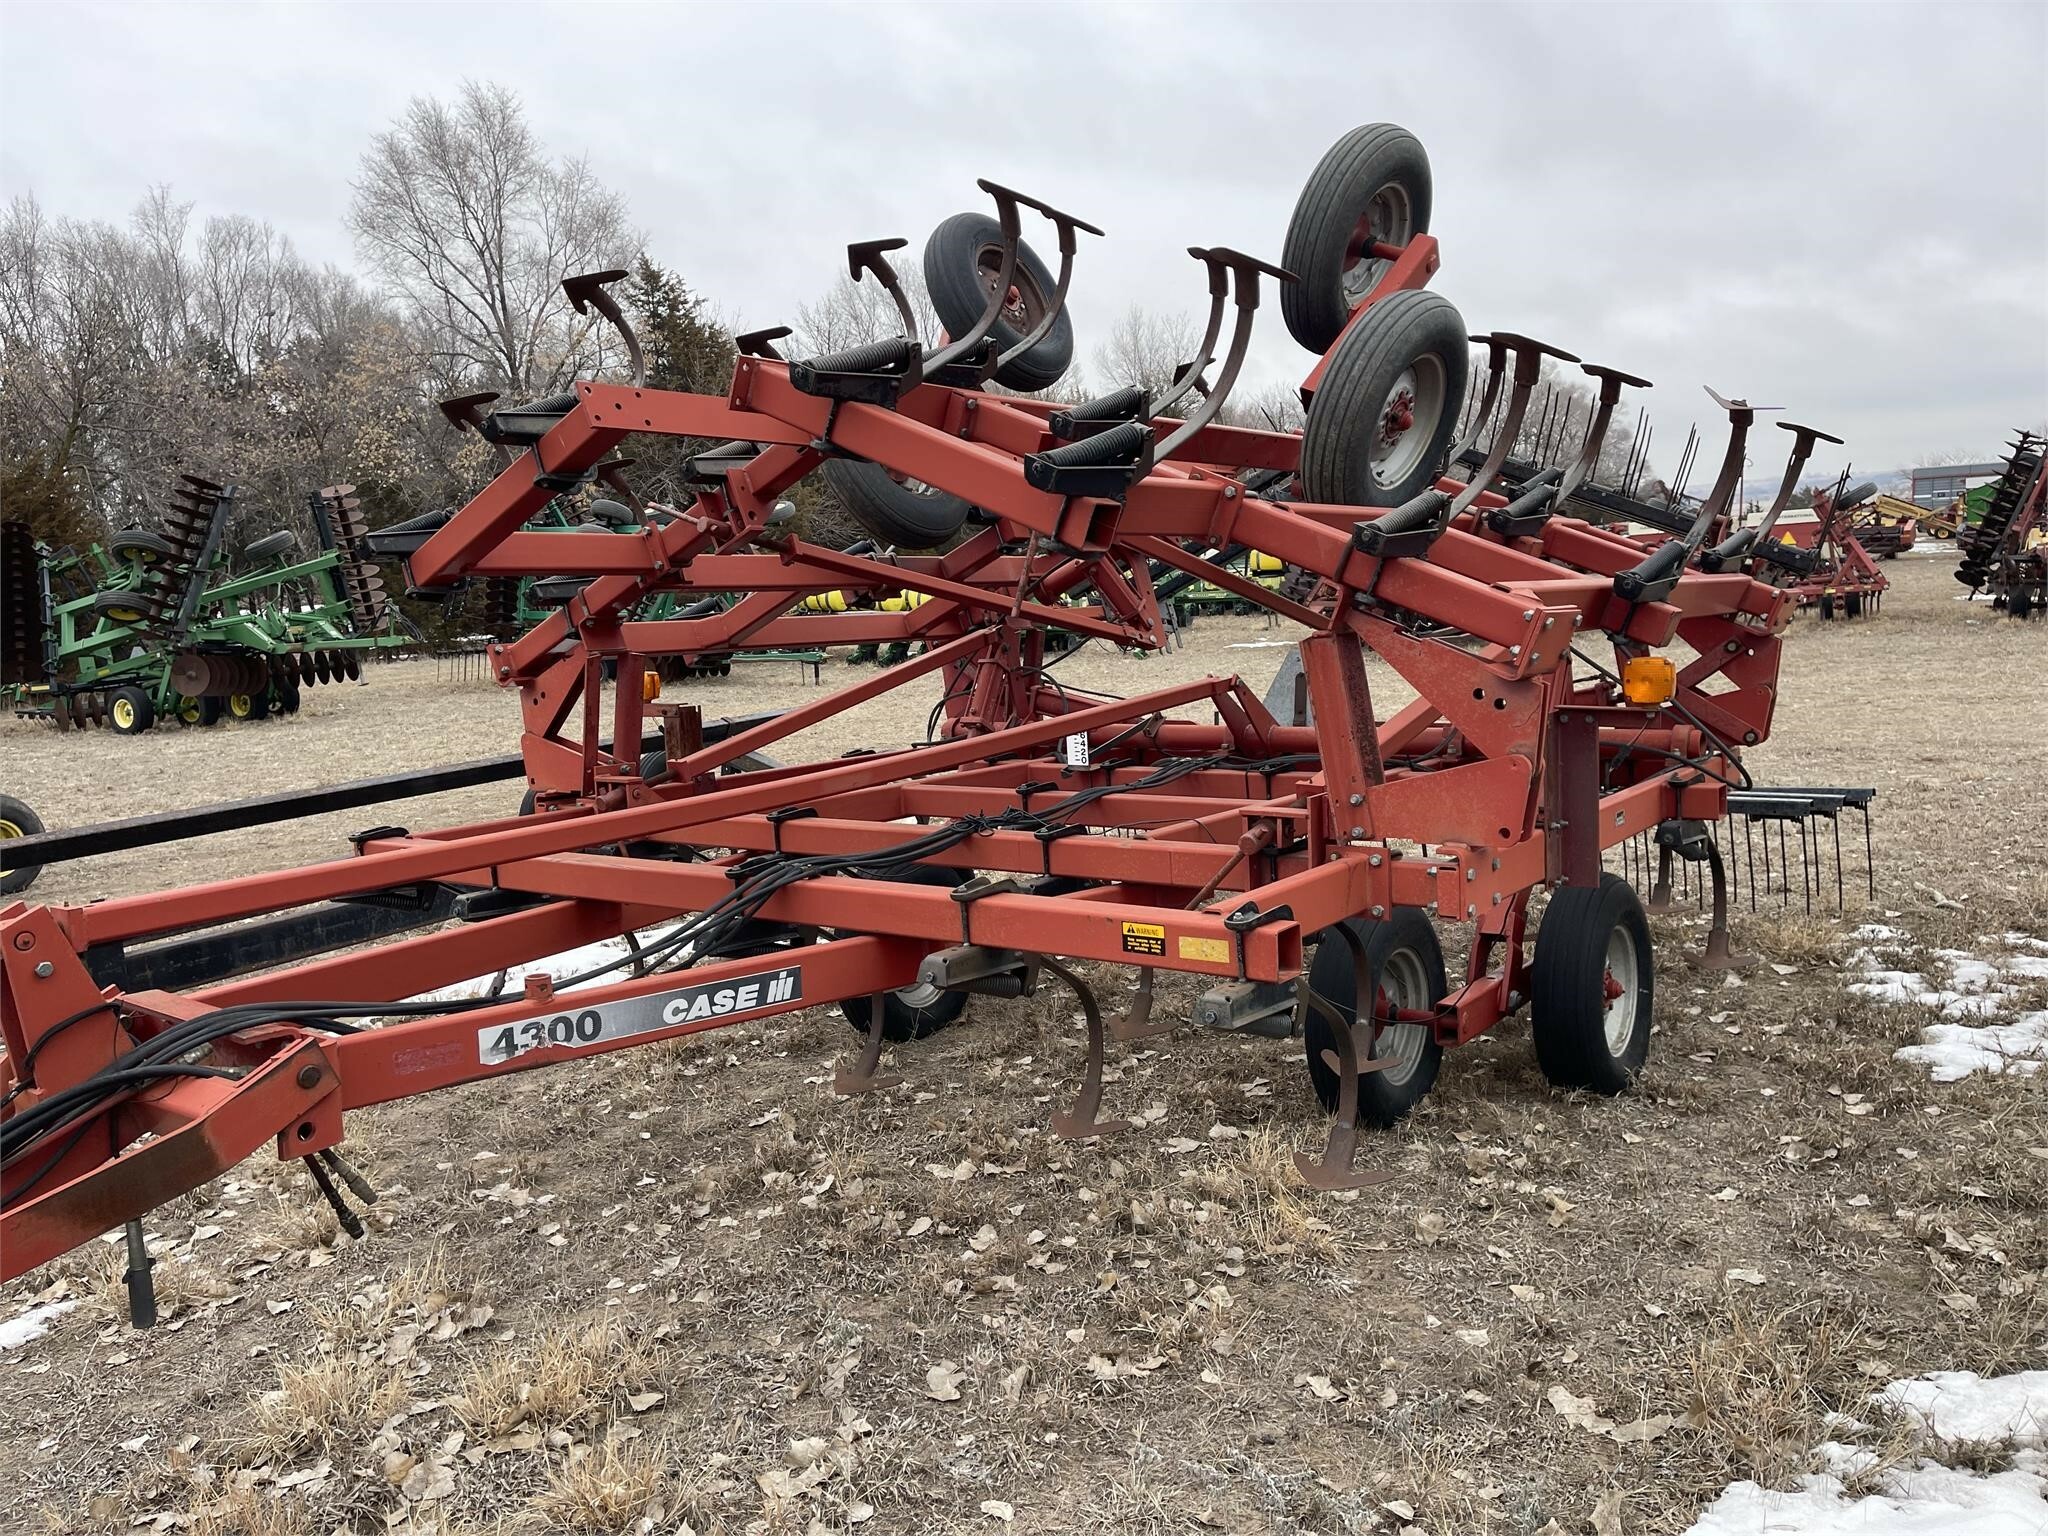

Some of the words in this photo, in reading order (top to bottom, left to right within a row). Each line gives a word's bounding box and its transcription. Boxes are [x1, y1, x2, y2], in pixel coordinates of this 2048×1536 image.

[1081, 748, 1086, 756] 2
[1081, 756, 1087, 764] 0
[1136, 927, 1160, 936] WARNING
[489, 1009, 602, 1058] 4300
[662, 983, 760, 1024] CASE
